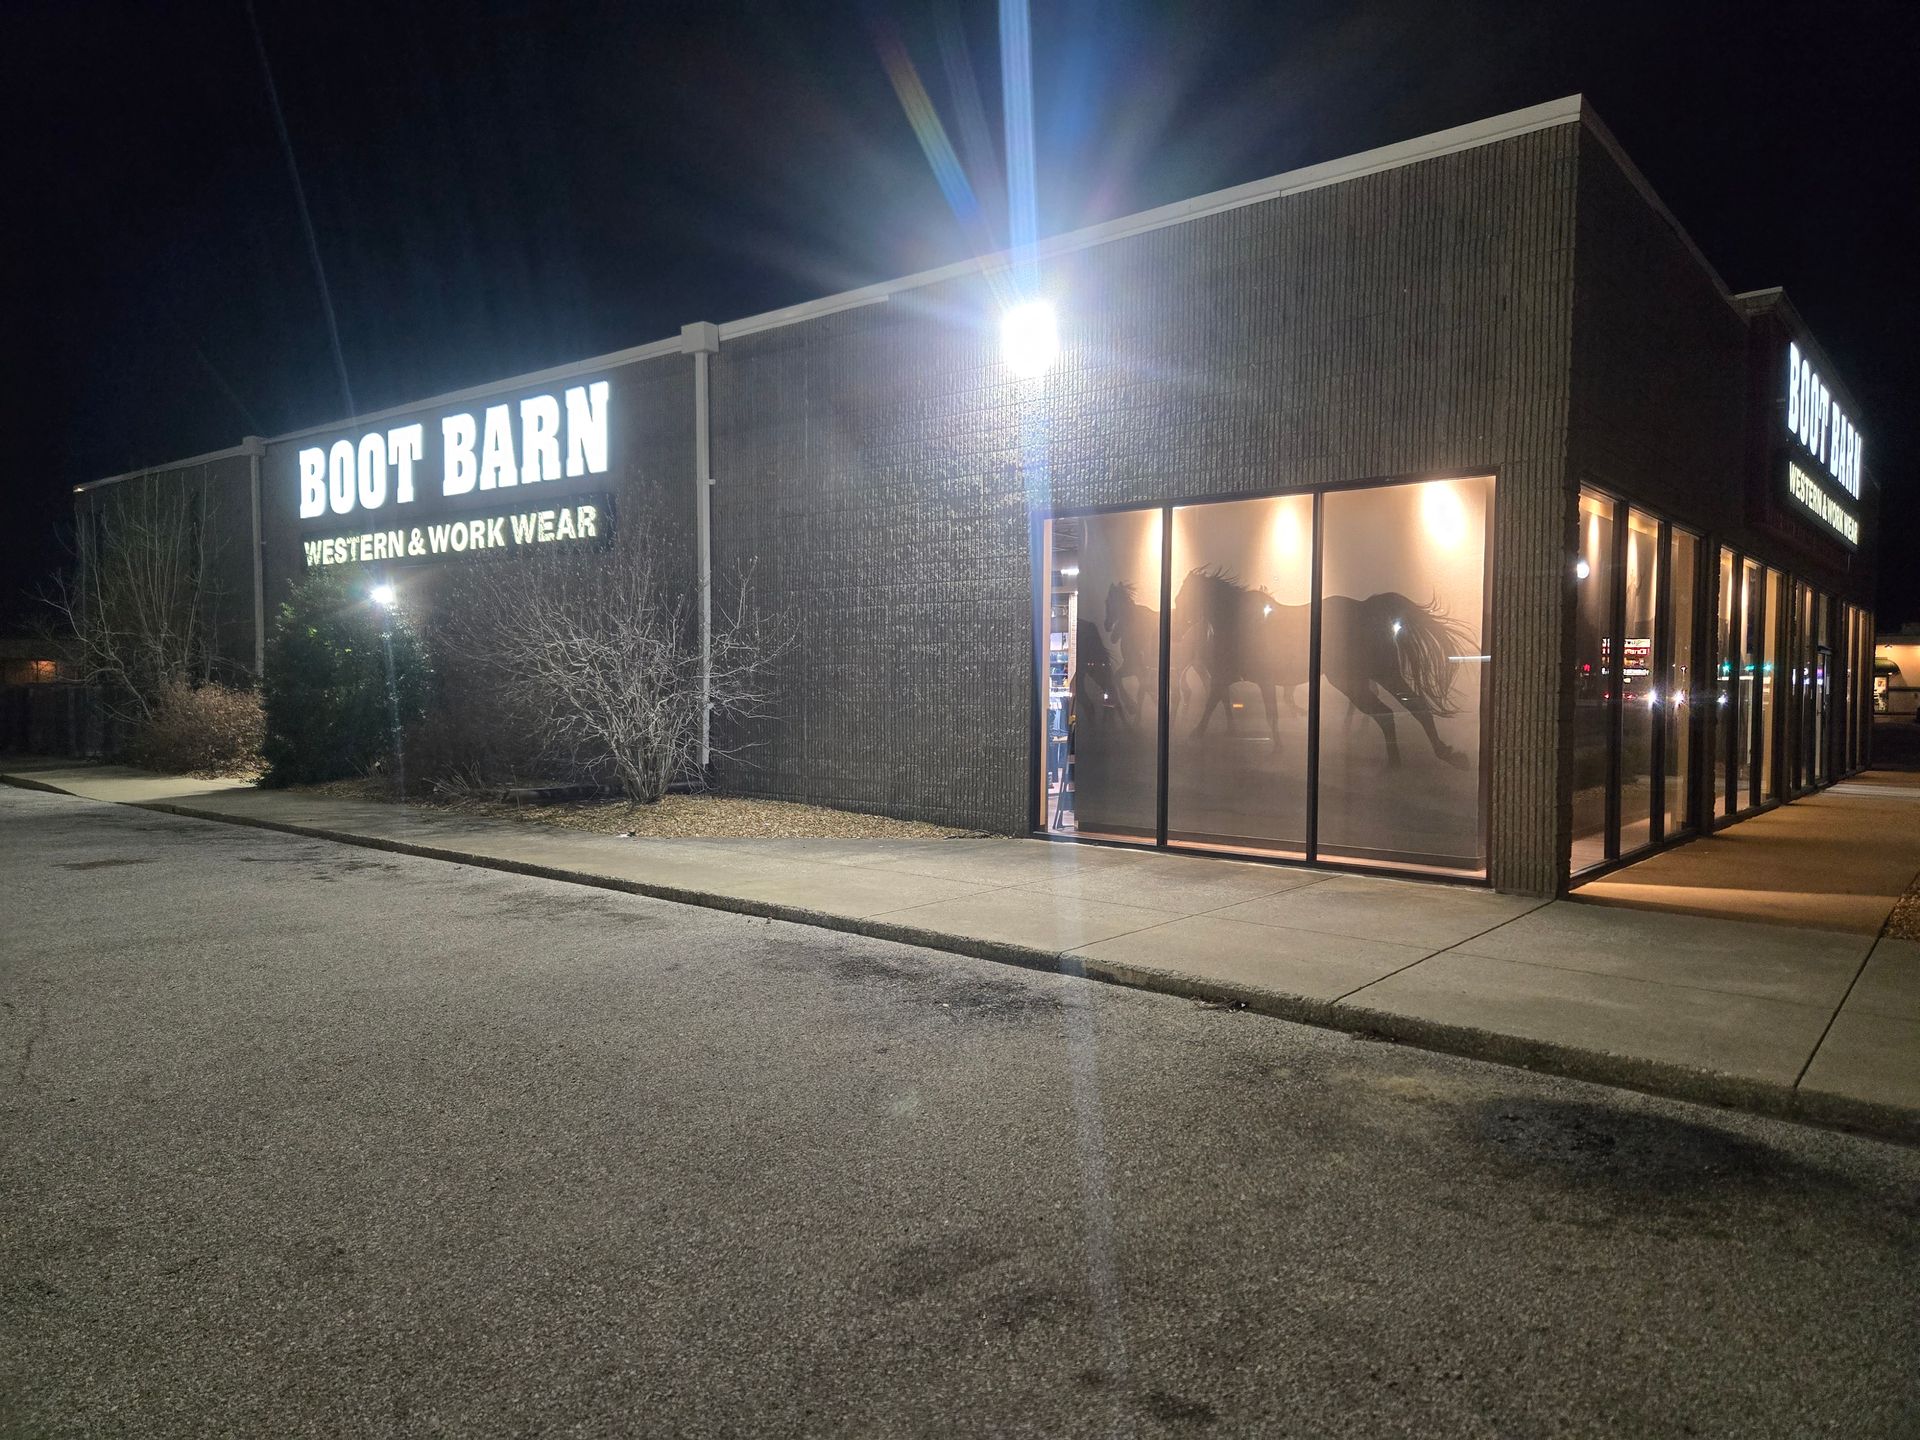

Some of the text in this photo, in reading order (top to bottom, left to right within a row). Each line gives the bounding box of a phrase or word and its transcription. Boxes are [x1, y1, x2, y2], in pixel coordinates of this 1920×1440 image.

[299, 381, 609, 519] BOOT BARN
[1788, 342, 1861, 500] BOOT BARN
[304, 505, 597, 566] WESTERN & WORK WEAR
